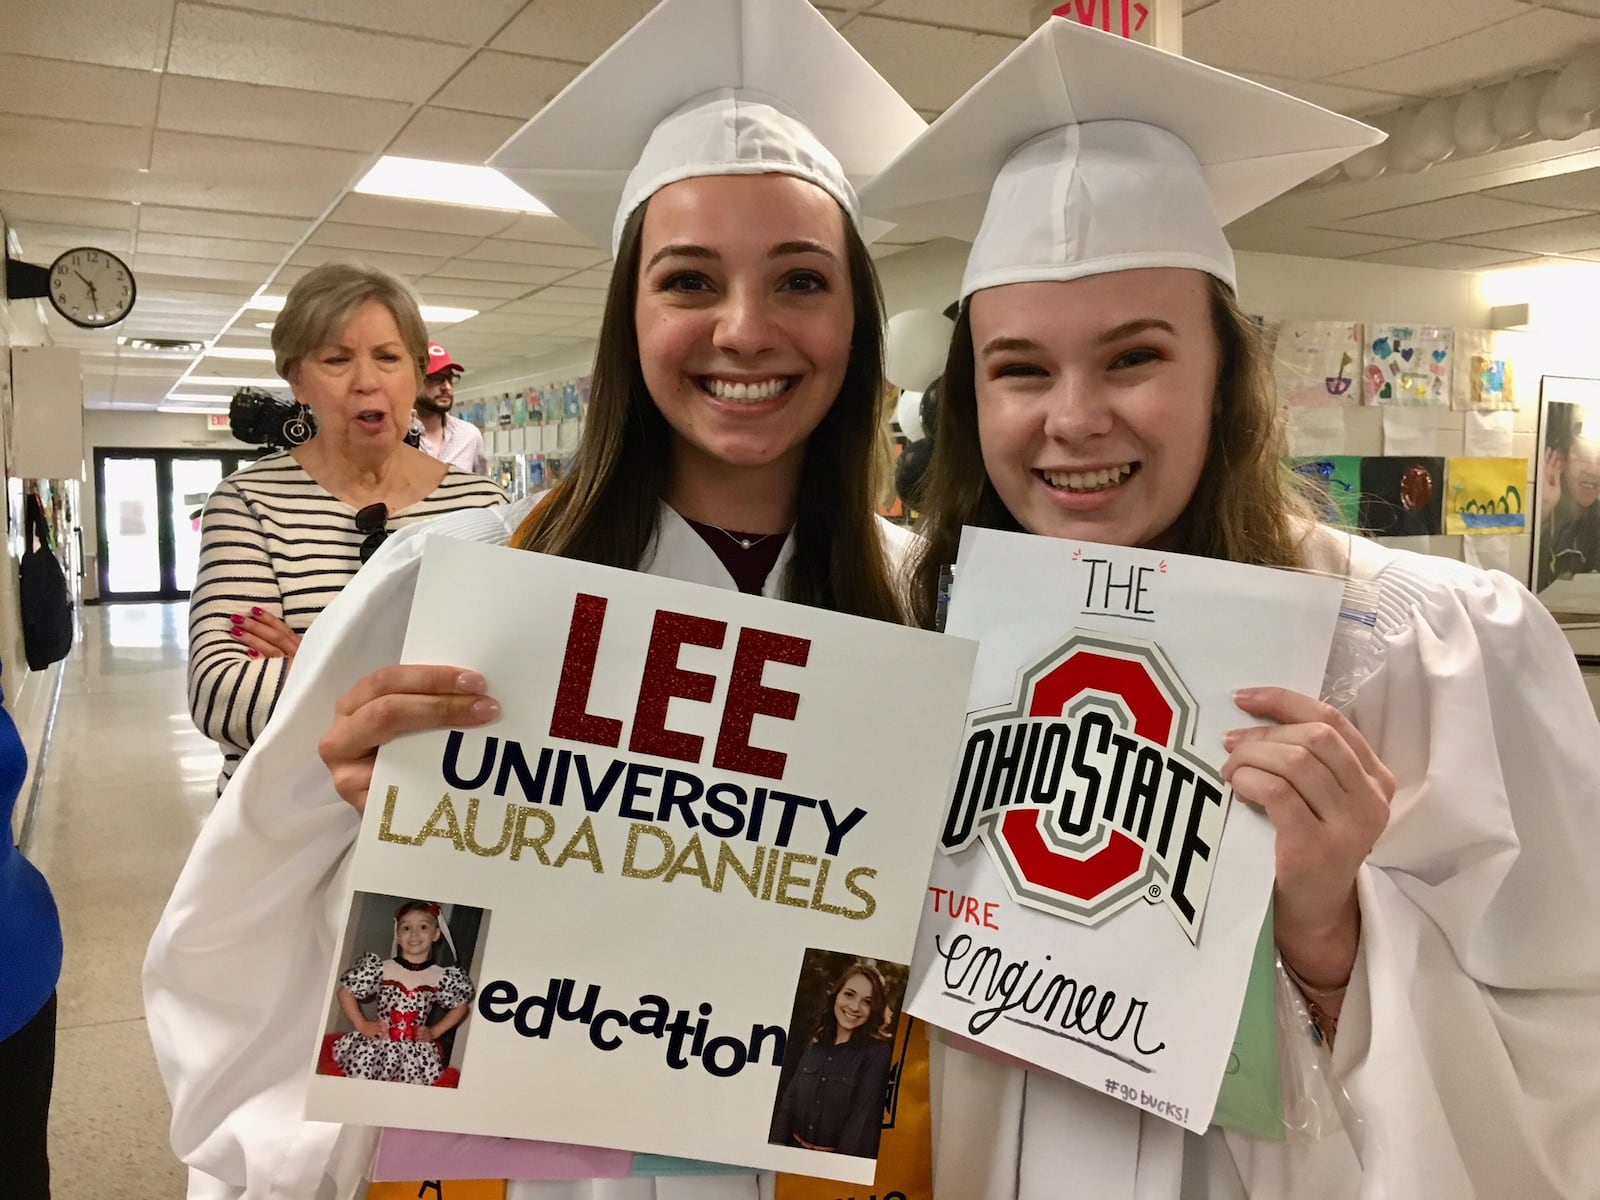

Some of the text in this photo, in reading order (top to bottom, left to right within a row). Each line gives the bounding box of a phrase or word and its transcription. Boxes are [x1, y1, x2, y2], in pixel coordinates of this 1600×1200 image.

[72, 255, 80, 266] 11
[87, 252, 98, 263] 12
[57, 264, 69, 275] 10
[106, 259, 110, 269] 1
[117, 270, 124, 281] 2
[54, 279, 62, 288] 9
[121, 285, 128, 296] 3
[58, 293, 66, 304] 8
[115, 300, 123, 309] 4
[72, 306, 79, 316] 7
[1082, 558, 1155, 614] THE
[549, 592, 812, 780] LEE
[442, 730, 867, 857] UNIVERSITY
[941, 711, 1223, 925] OHIO STATE
[379, 785, 877, 921] LAURA DANIELS
[935, 934, 1166, 1055] engineer
[478, 978, 788, 1077] education
[1104, 1078, 1138, 1101] #go
